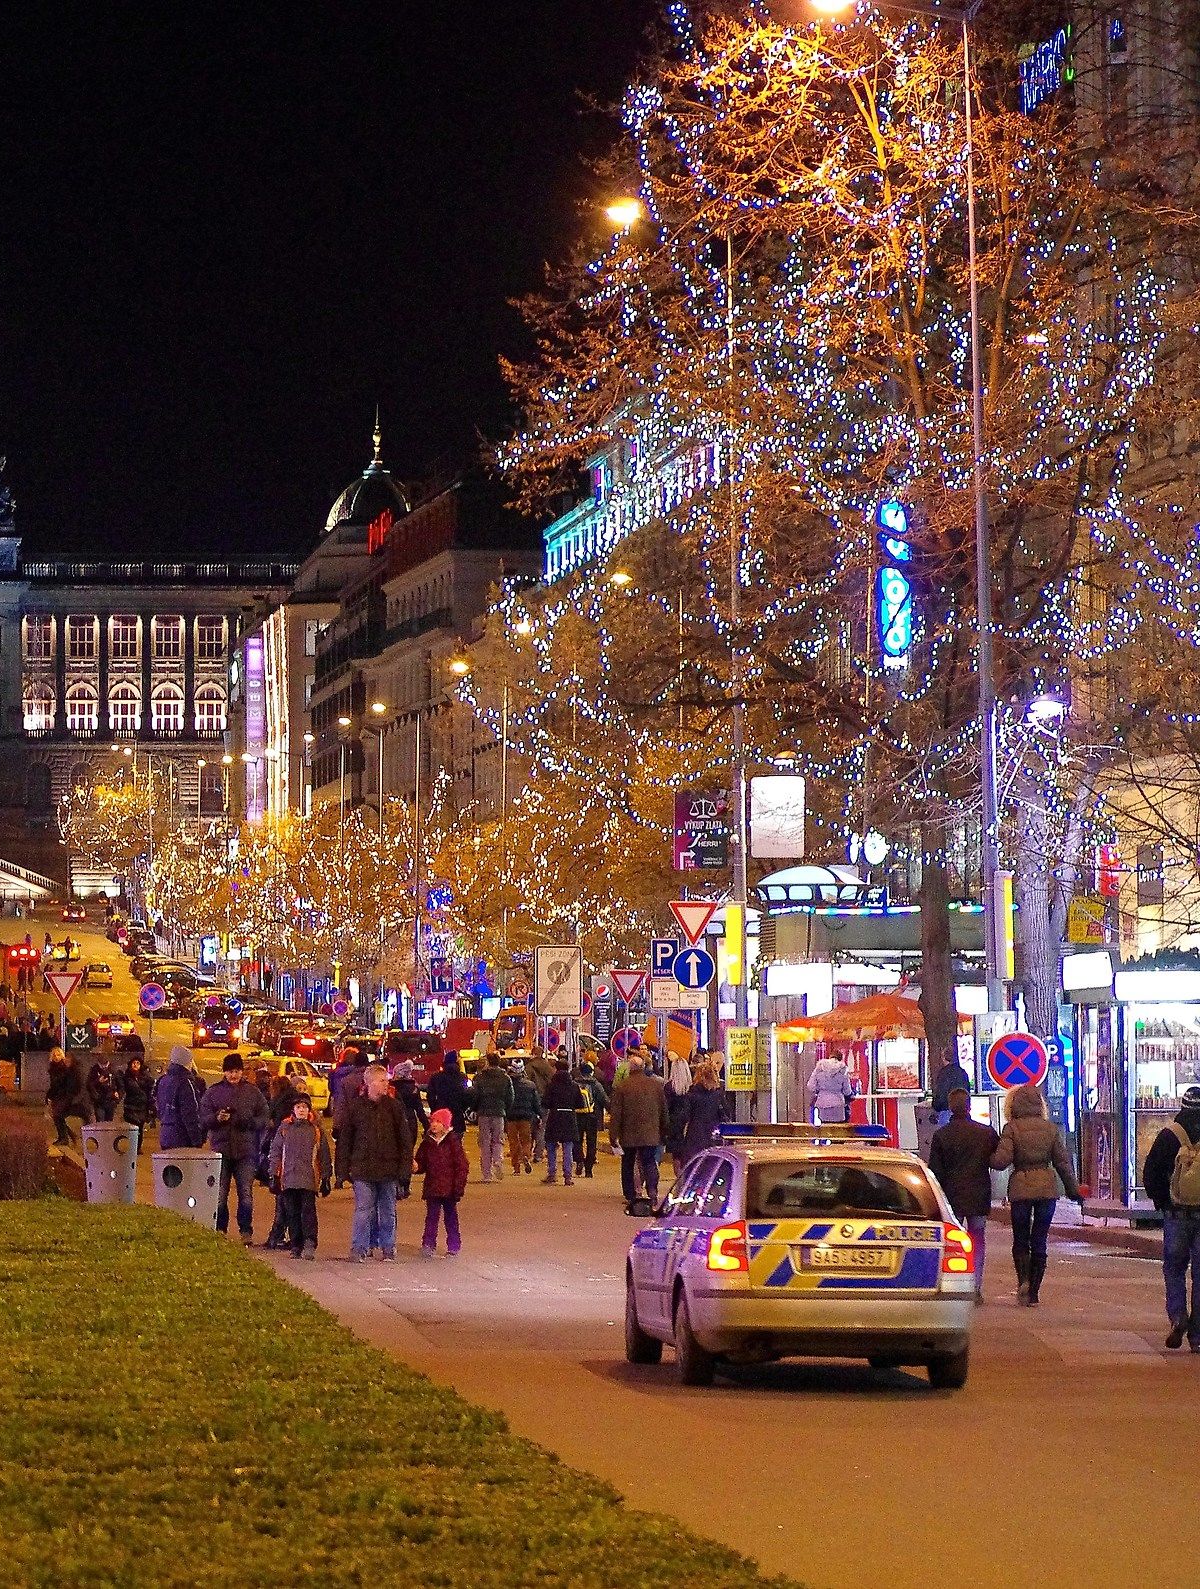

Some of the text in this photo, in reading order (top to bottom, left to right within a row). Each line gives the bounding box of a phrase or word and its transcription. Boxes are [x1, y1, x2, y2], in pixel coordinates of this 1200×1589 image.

[684, 819, 723, 830] VÝKUP ZLATA
[657, 943, 674, 967] P
[875, 1226, 936, 1240] POLICIE
